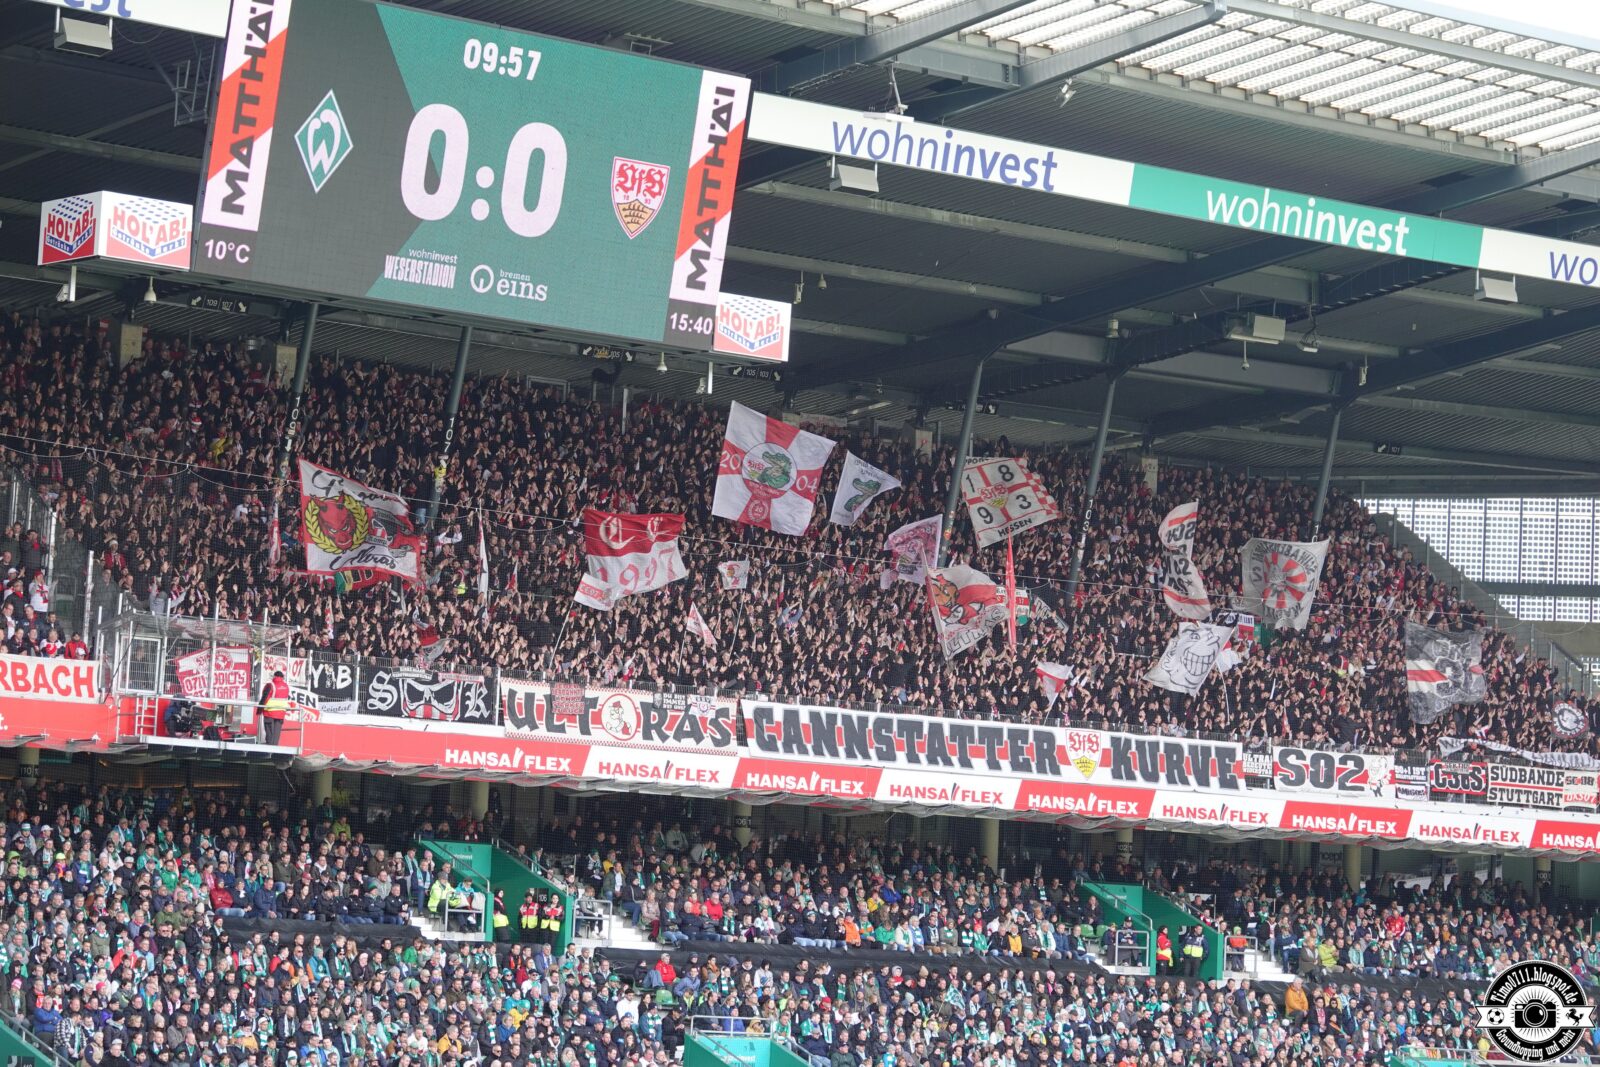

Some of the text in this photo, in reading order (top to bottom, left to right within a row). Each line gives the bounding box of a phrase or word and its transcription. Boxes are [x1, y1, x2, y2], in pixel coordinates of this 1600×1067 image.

[463, 38, 542, 81] 09:57
[400, 103, 568, 238] 0:0
[832, 119, 1058, 193] wohninvest
[47, 204, 94, 242] HOL'AB!
[112, 205, 187, 246] HOL'AB!
[1206, 188, 1409, 256] wohninvest
[204, 239, 250, 264] 10°C
[408, 248, 458, 264] wohninvest
[384, 255, 456, 289] WESERSTADION
[499, 269, 531, 281] bremen
[496, 279, 549, 302] eins
[669, 312, 713, 336] 15:40
[719, 304, 780, 341] HOL'AB!
[720, 450, 742, 472] 20
[795, 475, 818, 493] 04
[965, 464, 1014, 493] 1 8
[977, 494, 1032, 525] 9 3
[753, 706, 1240, 791] CANNSTATTER KURVE
[1490, 765, 1565, 787] SÜDBANDE
[1488, 787, 1564, 807] STUTTGART
[1542, 833, 1594, 849] HANSA
